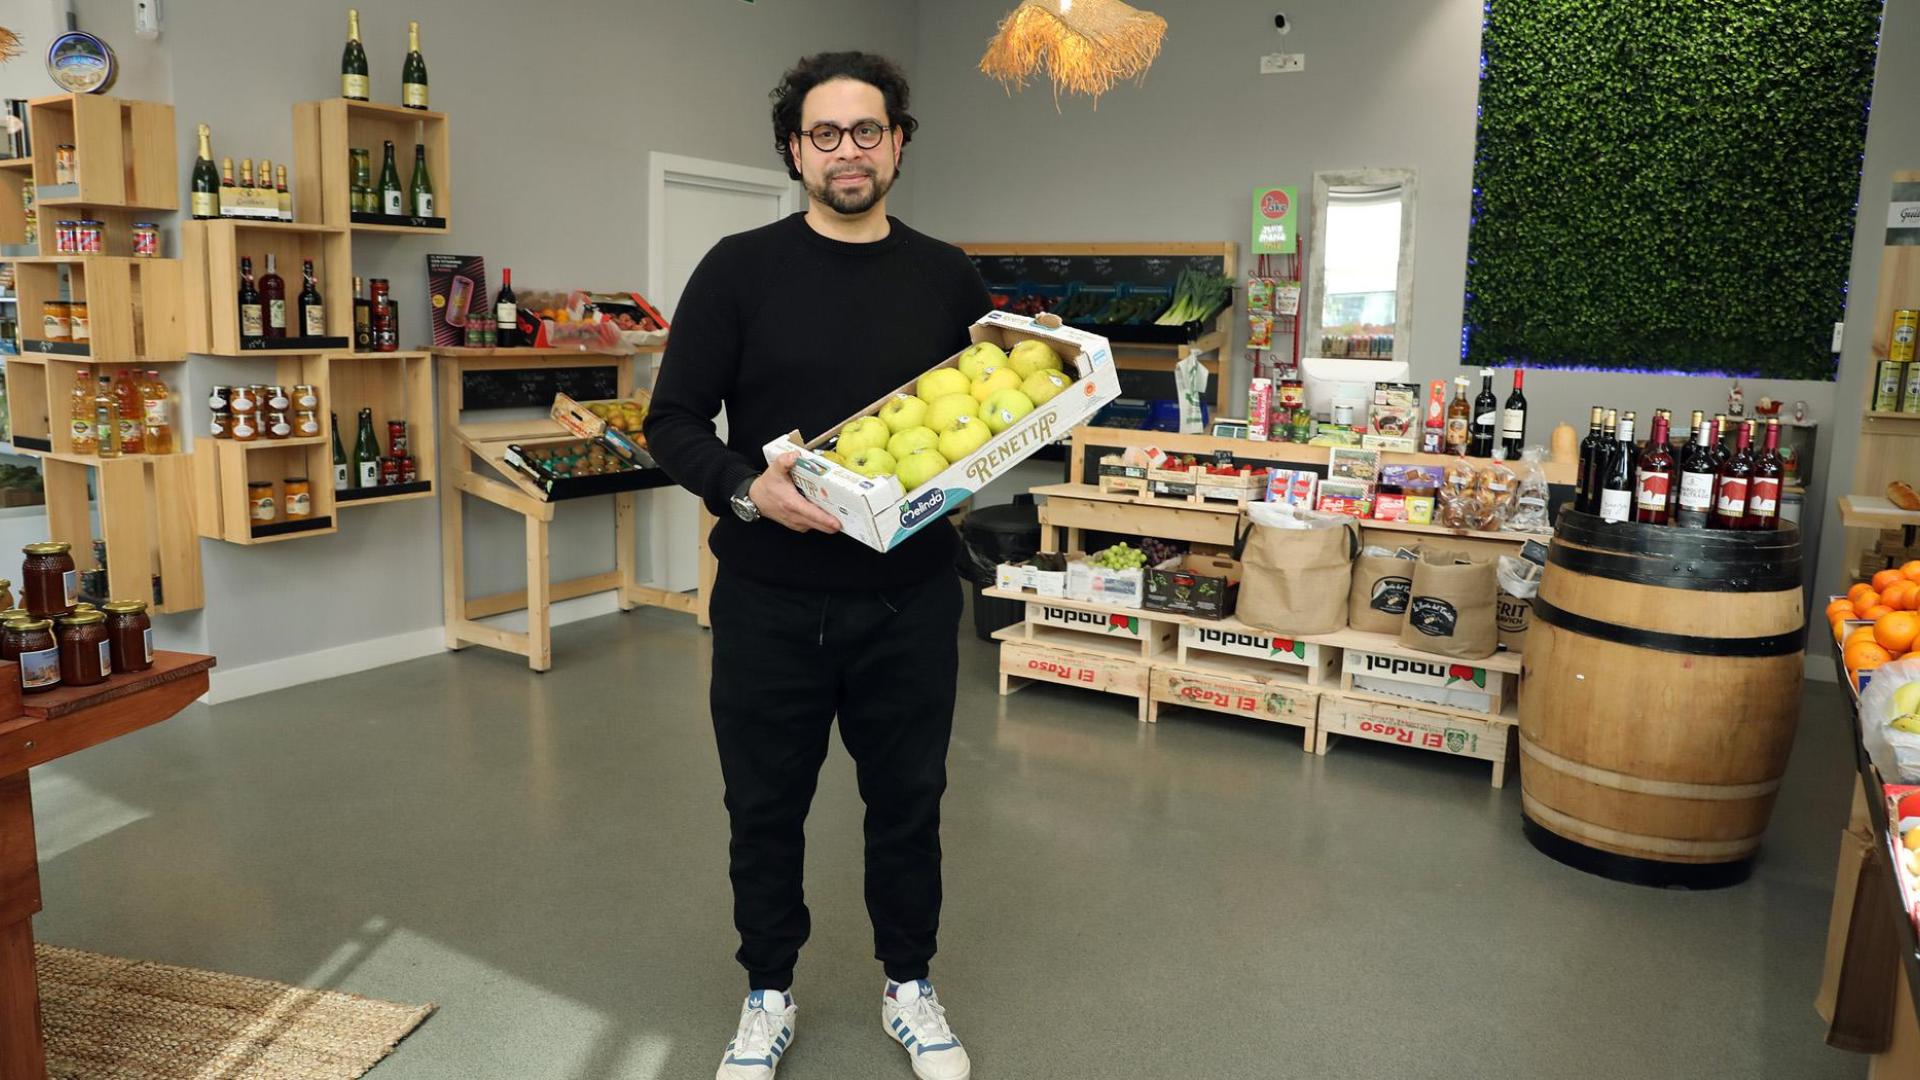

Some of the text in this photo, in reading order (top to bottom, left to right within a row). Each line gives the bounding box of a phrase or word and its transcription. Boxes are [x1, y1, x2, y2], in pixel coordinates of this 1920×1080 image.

[966, 411, 1058, 484] RENETTA
[901, 493, 943, 524] Melinda
[1043, 607, 1107, 626] nadal
[1199, 628, 1269, 649] nadal
[1028, 660, 1072, 679] Raso
[1078, 668, 1096, 683] El
[1366, 655, 1446, 677] nadal
[1181, 687, 1256, 712] El Raso
[1360, 722, 1413, 744] Raso
[1422, 733, 1443, 748] El
